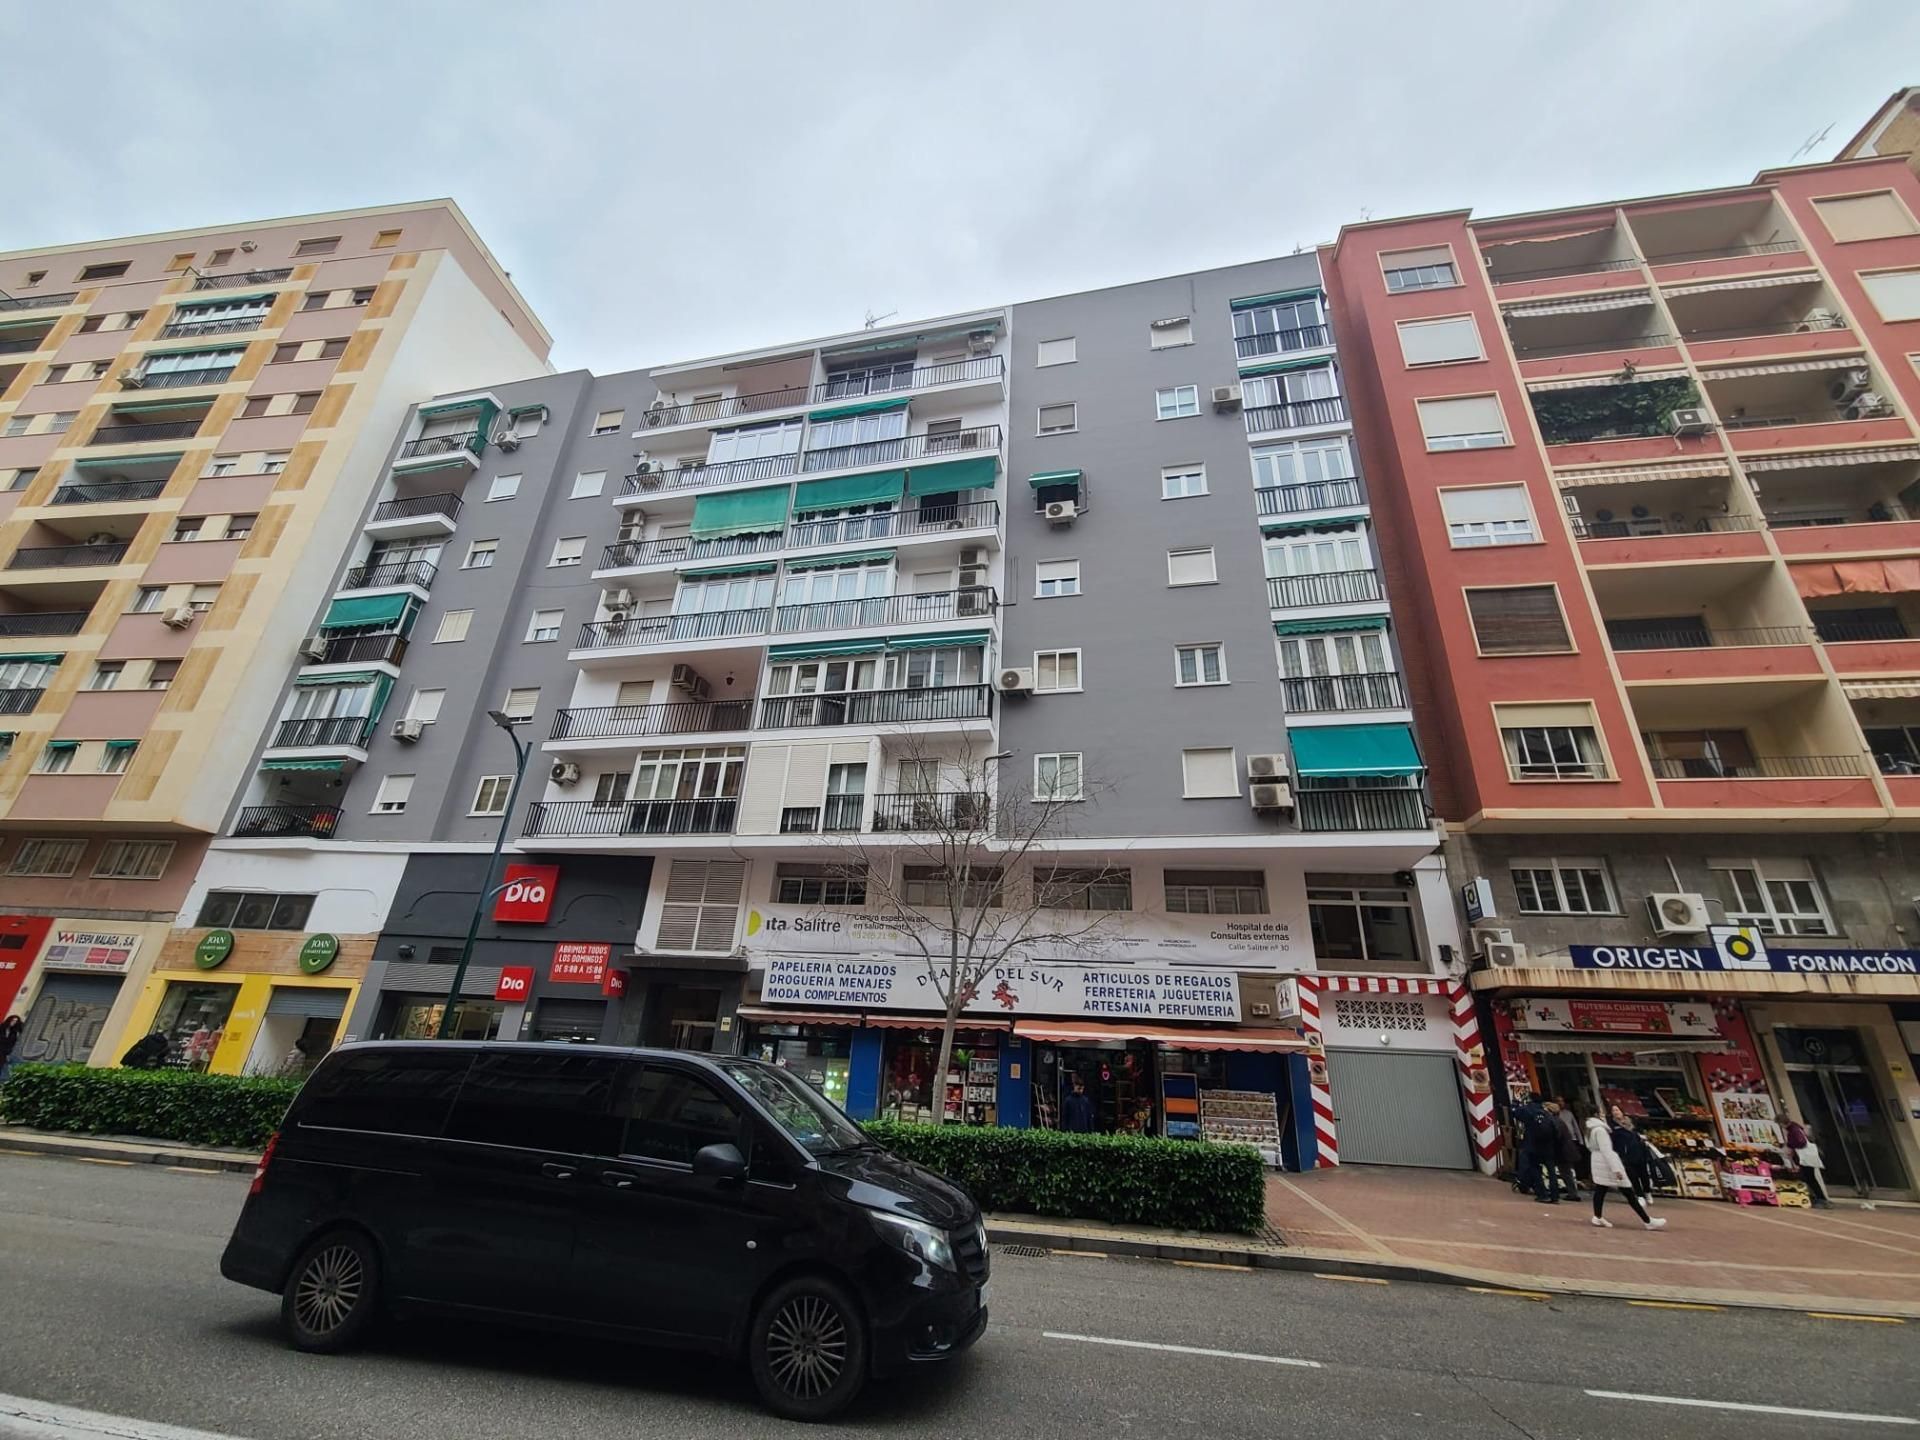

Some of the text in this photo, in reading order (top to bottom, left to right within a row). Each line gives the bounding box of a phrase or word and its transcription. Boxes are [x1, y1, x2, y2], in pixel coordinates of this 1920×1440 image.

[794, 917, 841, 932] Salitre
[1227, 922, 1262, 932] Hospital
[1263, 923, 1274, 931] de
[206, 936, 226, 944] JOAN
[1210, 932, 1290, 941] Consultas externas
[311, 940, 331, 948] JOAN
[559, 944, 608, 954] ABRIMOS TODOS
[1247, 943, 1269, 951] Salitre
[558, 954, 604, 964] LOS DOMINGOS
[1592, 946, 1917, 973] ORIGEN FORMACIÓN
[554, 964, 562, 973] DE
[578, 966, 584, 974] A
[771, 961, 897, 976] PAPELERIA CALZADOS
[769, 974, 893, 990] DROGUERIA MENAJES
[996, 968, 1024, 980] DEL
[1031, 970, 1064, 993] SUR
[1083, 972, 1232, 988] ARTICULOS DE REGALOS
[768, 988, 888, 1003] MODA COMPLEMENTOS
[1085, 986, 1234, 1002] FERRETERIA JUGUETERIA
[1084, 1000, 1235, 1017] ARTESANIA PERFUMERIA
[1572, 1002, 1662, 1012] FRUTERIA CUARTELES
